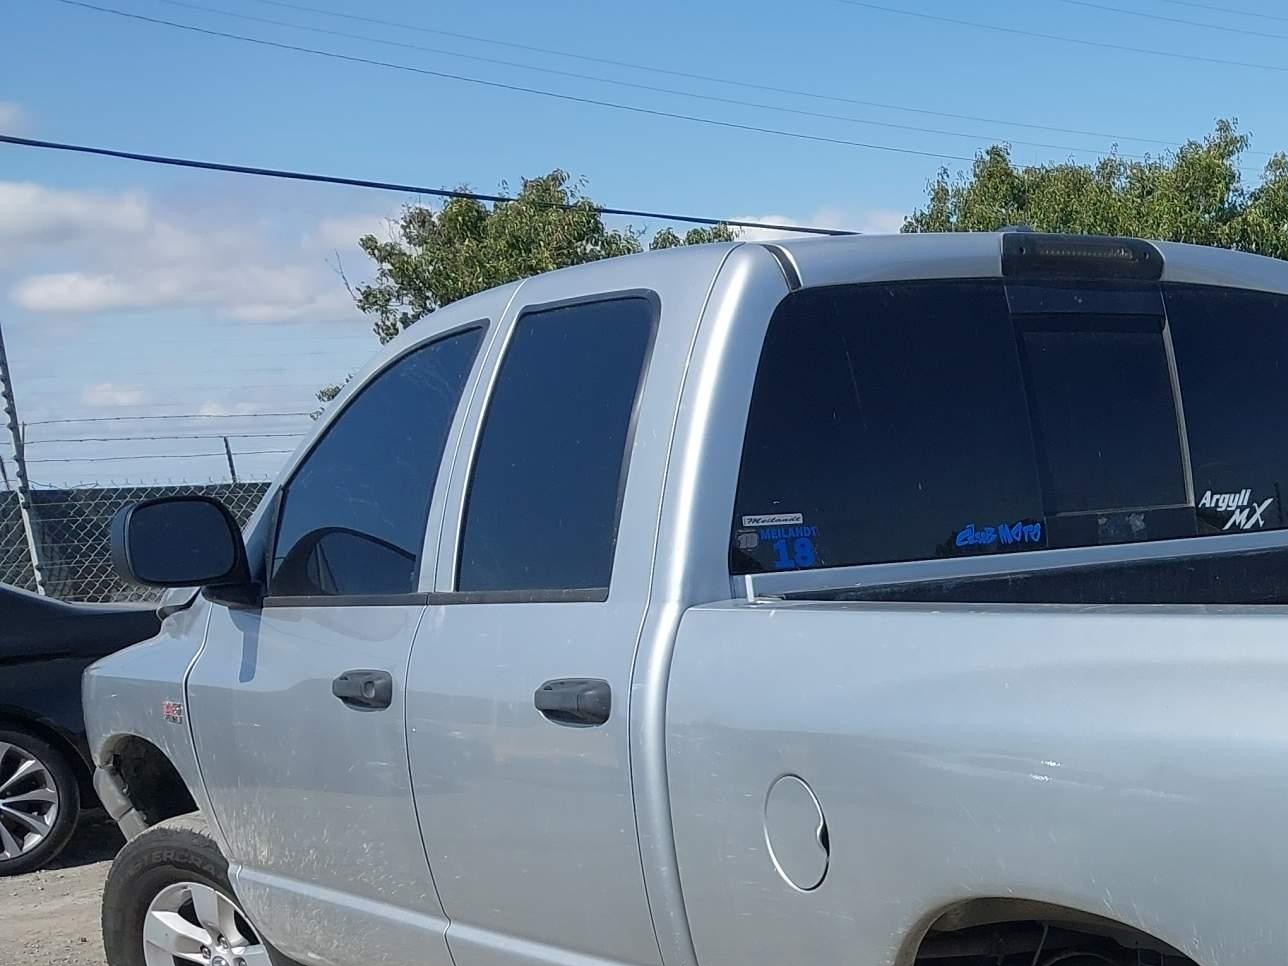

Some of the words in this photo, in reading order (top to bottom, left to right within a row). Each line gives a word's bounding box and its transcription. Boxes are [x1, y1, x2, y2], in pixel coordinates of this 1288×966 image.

[1197, 488, 1253, 512] Argyll
[1222, 497, 1275, 531] MX
[760, 526, 817, 540] MEILANDT
[771, 536, 817, 569] 18
